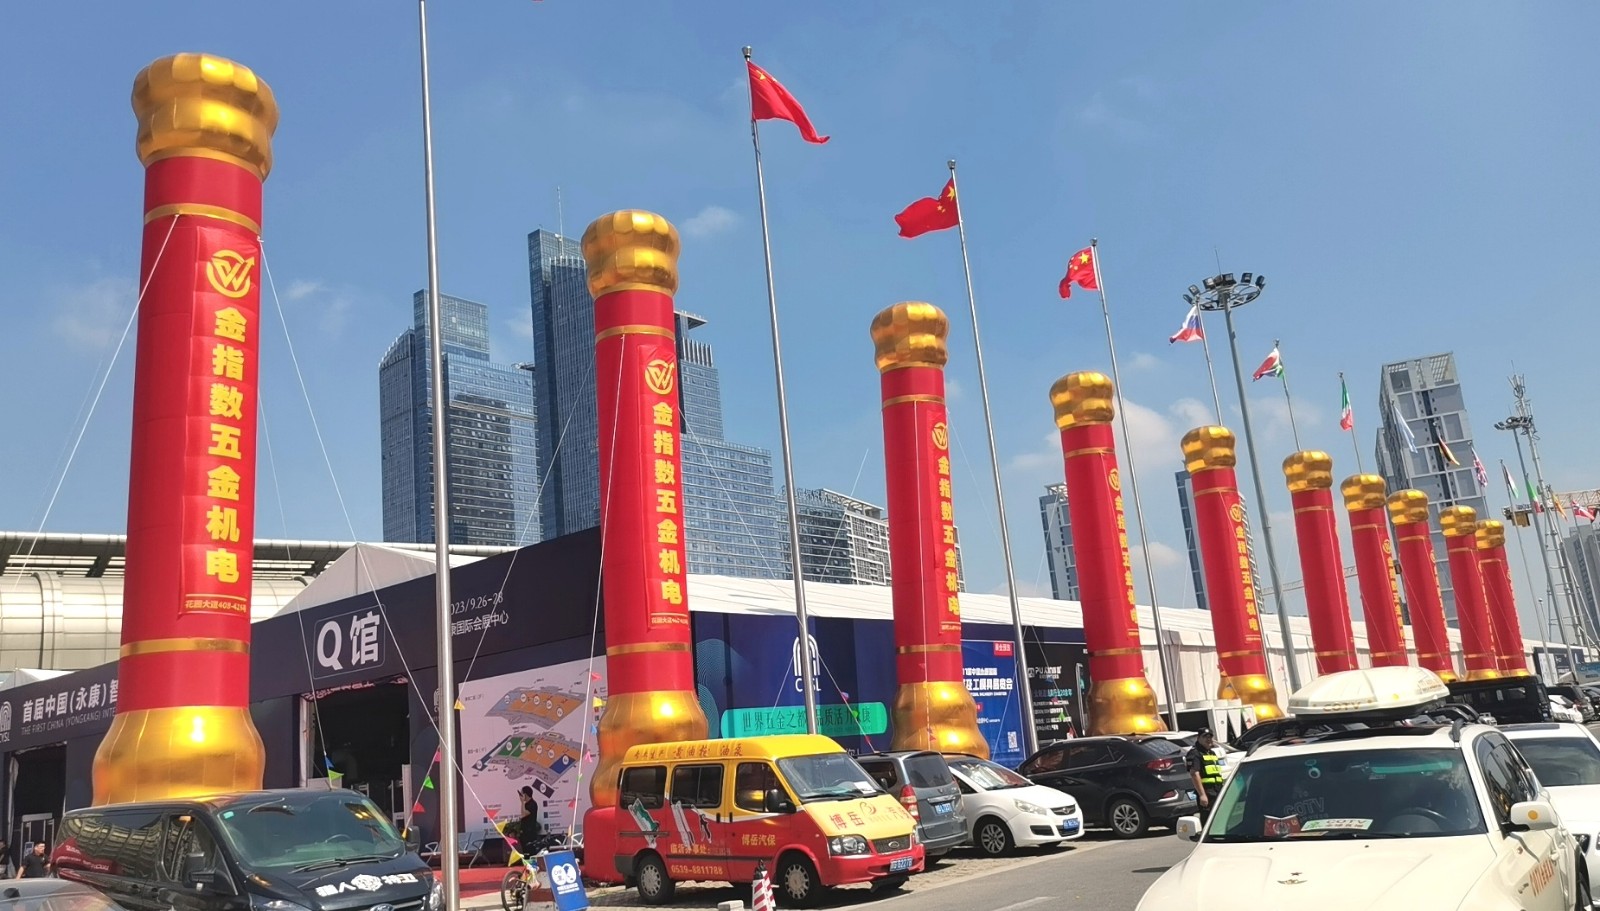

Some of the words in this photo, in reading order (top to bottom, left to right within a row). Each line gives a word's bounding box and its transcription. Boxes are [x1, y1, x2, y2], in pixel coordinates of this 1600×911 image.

[206, 306, 248, 584] 金指数五金机电
[652, 401, 683, 605] 金指数五金机电
[937, 455, 960, 616] 金指数五金机电
[1235, 525, 1259, 631] 金指数五金机电
[963, 677, 1013, 691] 及工模具展览会
[742, 833, 777, 846] 博岳汽保
